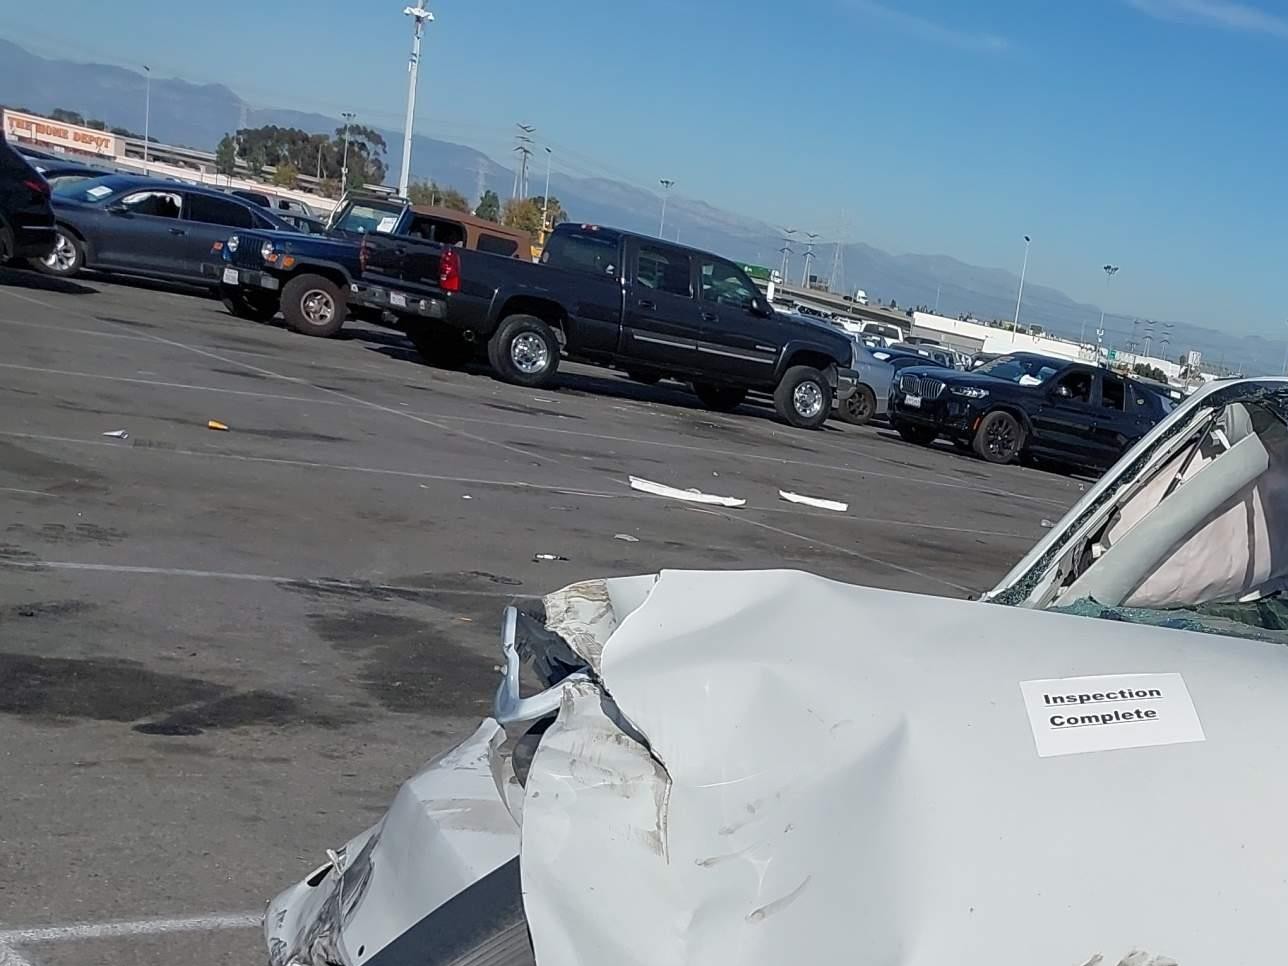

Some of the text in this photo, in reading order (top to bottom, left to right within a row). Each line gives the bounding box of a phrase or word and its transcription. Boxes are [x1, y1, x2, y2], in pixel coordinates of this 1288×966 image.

[36, 123, 69, 139] HOME
[73, 131, 111, 148] DEPOT
[1043, 687, 1163, 705] Inspection
[1049, 708, 1158, 727] Complete
